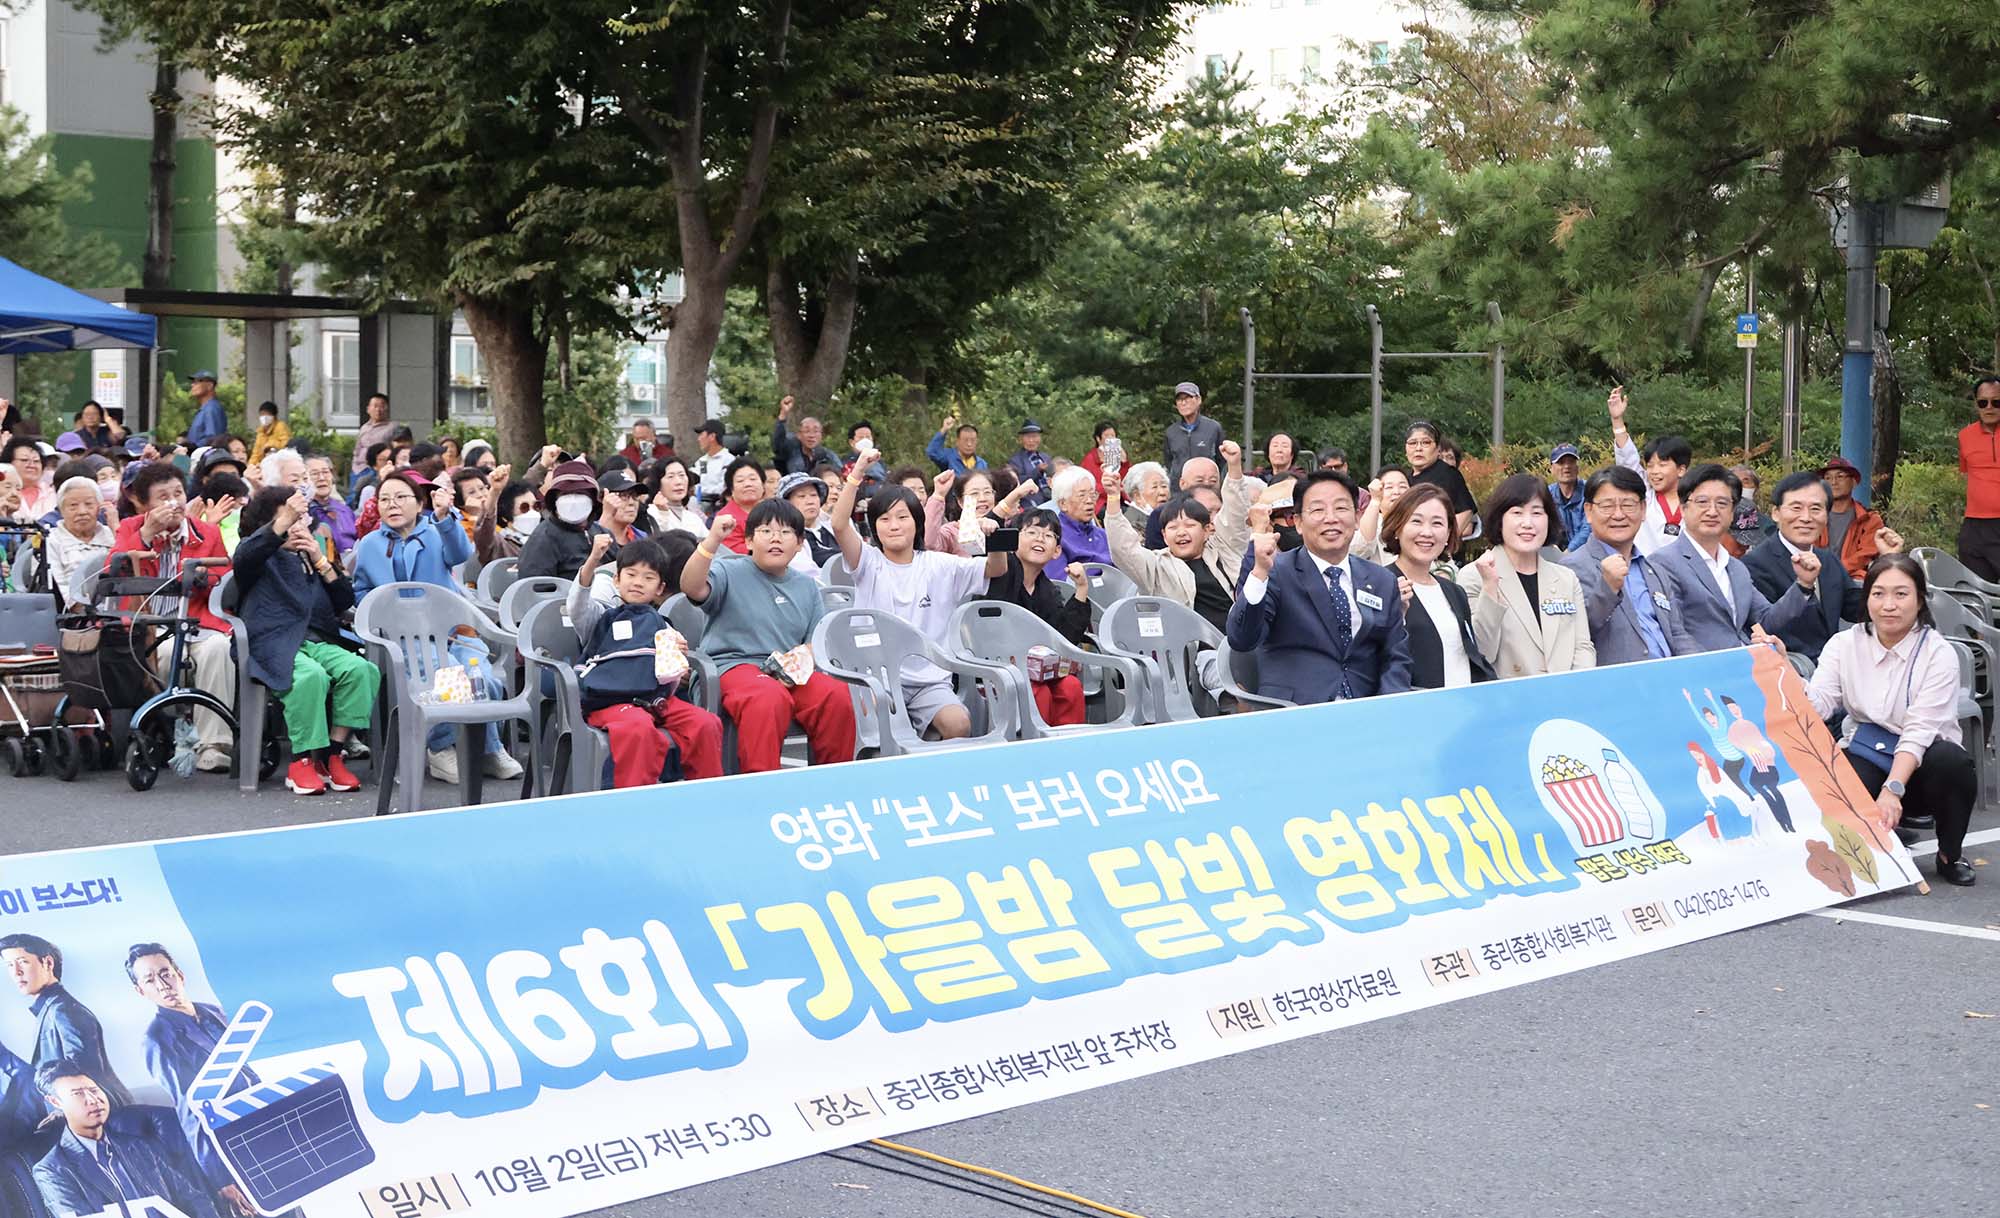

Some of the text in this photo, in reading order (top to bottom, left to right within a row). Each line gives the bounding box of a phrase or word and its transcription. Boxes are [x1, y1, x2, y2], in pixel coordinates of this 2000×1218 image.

[1742, 323, 1753, 331] 40
[769, 801, 881, 871] 영화
[1002, 771, 1101, 831] 보러
[1096, 758, 1220, 817] 오세요
[1574, 838, 1692, 883] 팝콘 생수 제공
[0, 877, 123, 916] 이 보스다!
[1631, 903, 1667, 933] 문의
[1674, 879, 1770, 920] 042)628-1476
[332, 919, 733, 1100] 제6회
[1088, 824, 1309, 960] 달빛
[1480, 914, 1617, 971] 중리종합사회복지관
[1431, 950, 1470, 983] 주관
[1218, 999, 1265, 1032] 지원
[1272, 967, 1402, 1021] 한국영상자료원
[883, 1020, 1177, 1111] 중리종합사회복지관 앞 주차장
[810, 1092, 871, 1127] 장소
[474, 1113, 772, 1199] 10월 2일(금) 저녁 5:30
[379, 1175, 453, 1218] 일시
